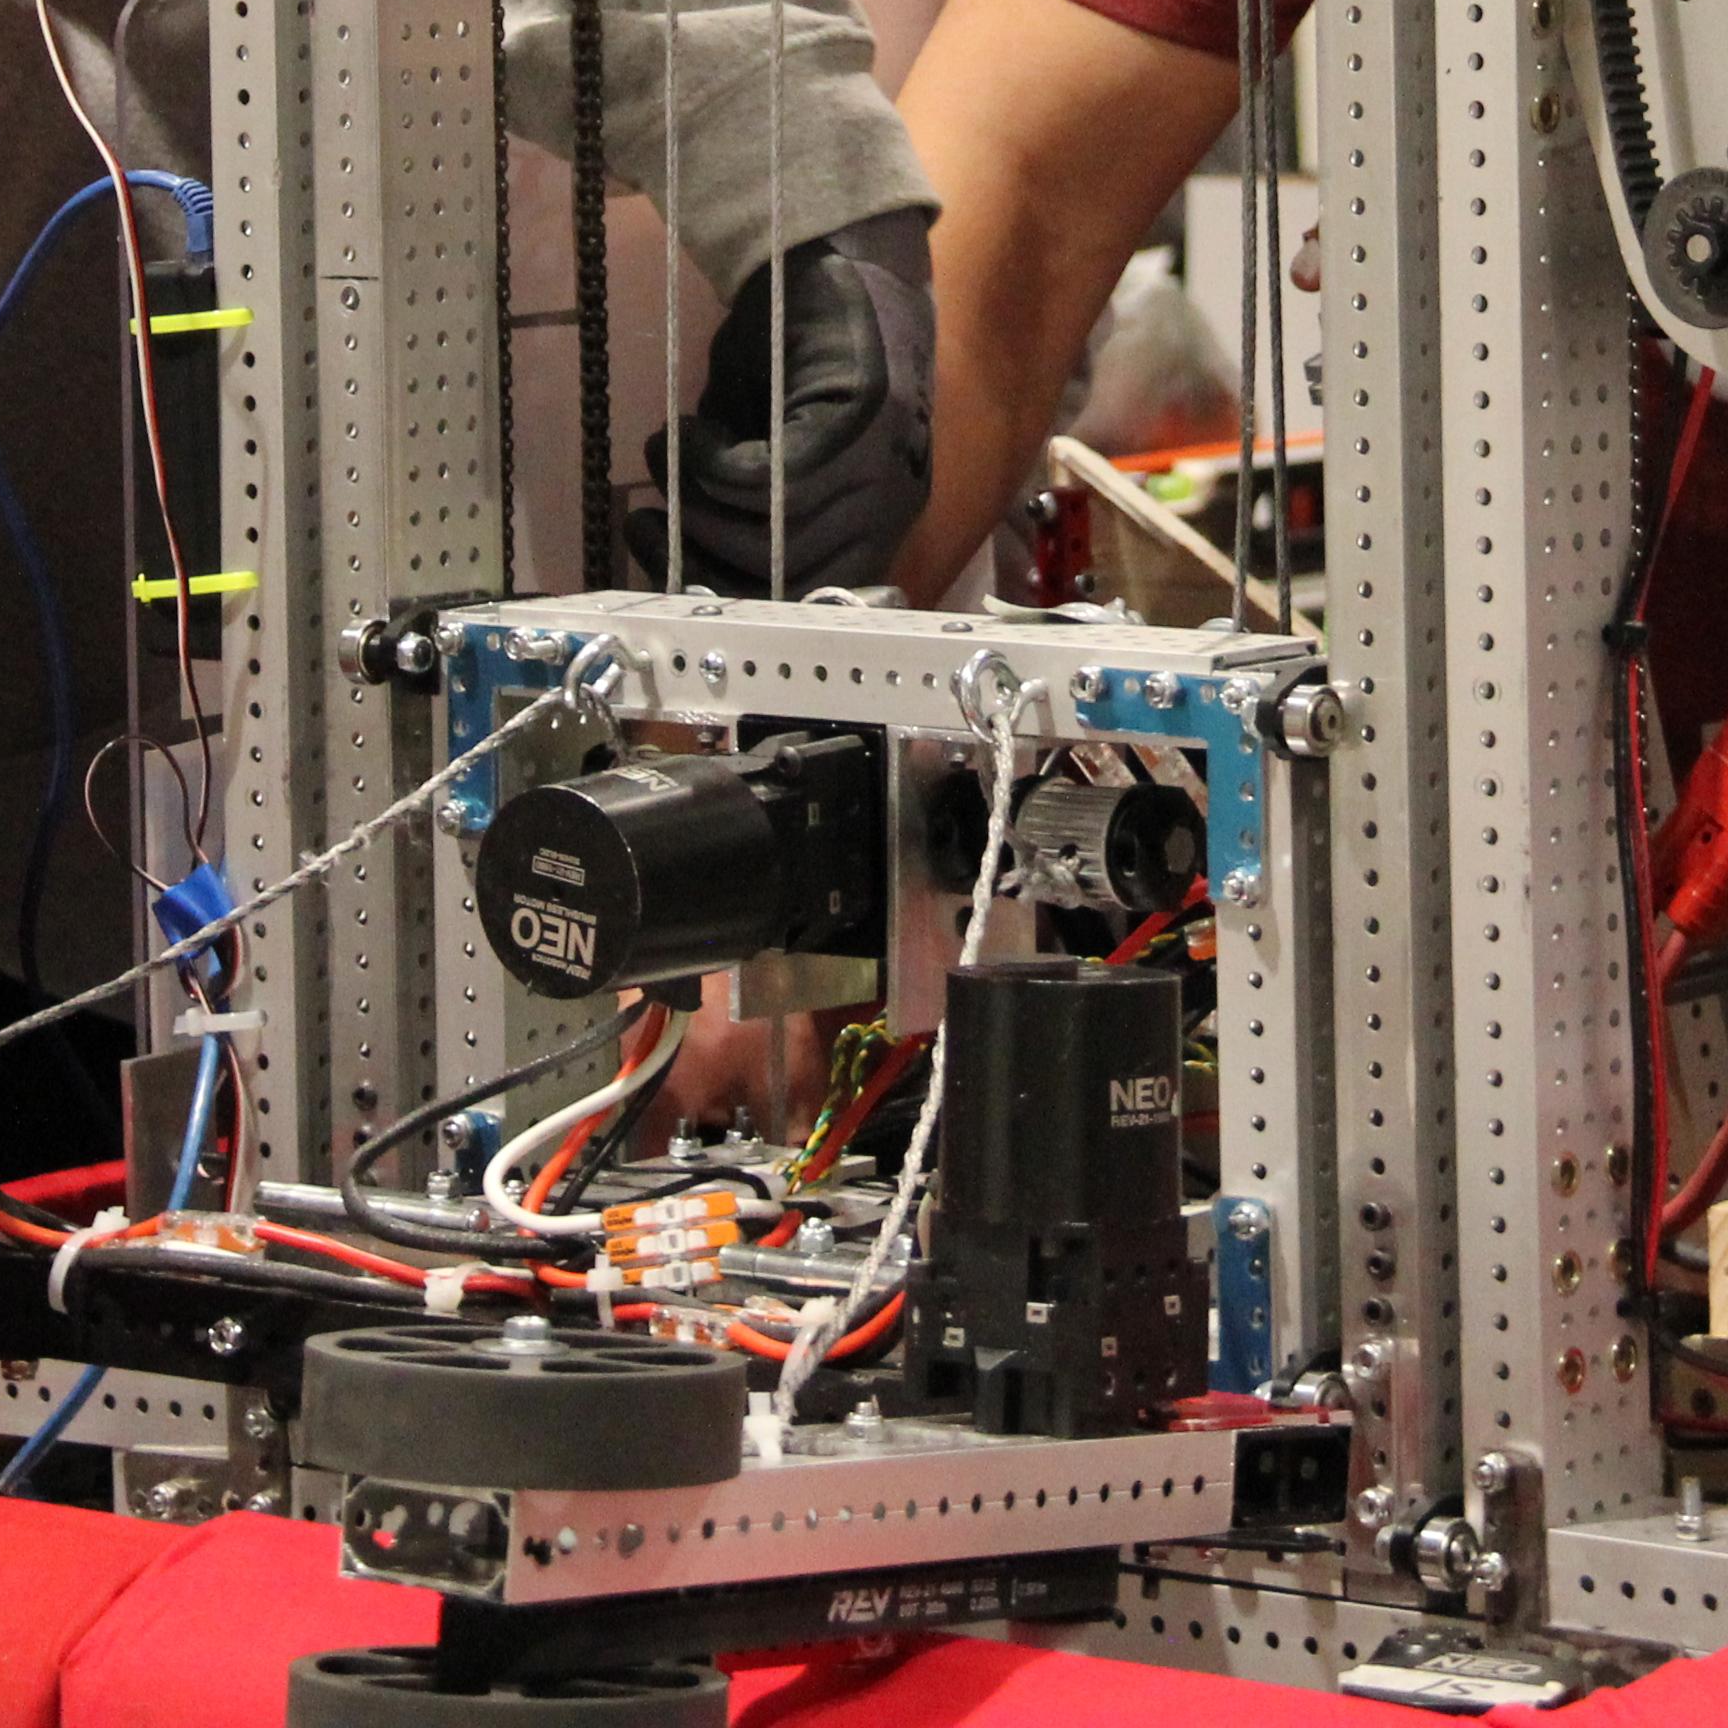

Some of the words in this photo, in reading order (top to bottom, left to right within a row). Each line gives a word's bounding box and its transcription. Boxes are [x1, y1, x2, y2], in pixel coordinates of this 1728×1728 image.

[511, 907, 596, 967] NEO
[1110, 1075, 1170, 1111] NEO
[828, 1587, 893, 1622] REV
[1415, 1652, 1542, 1677] NEO
